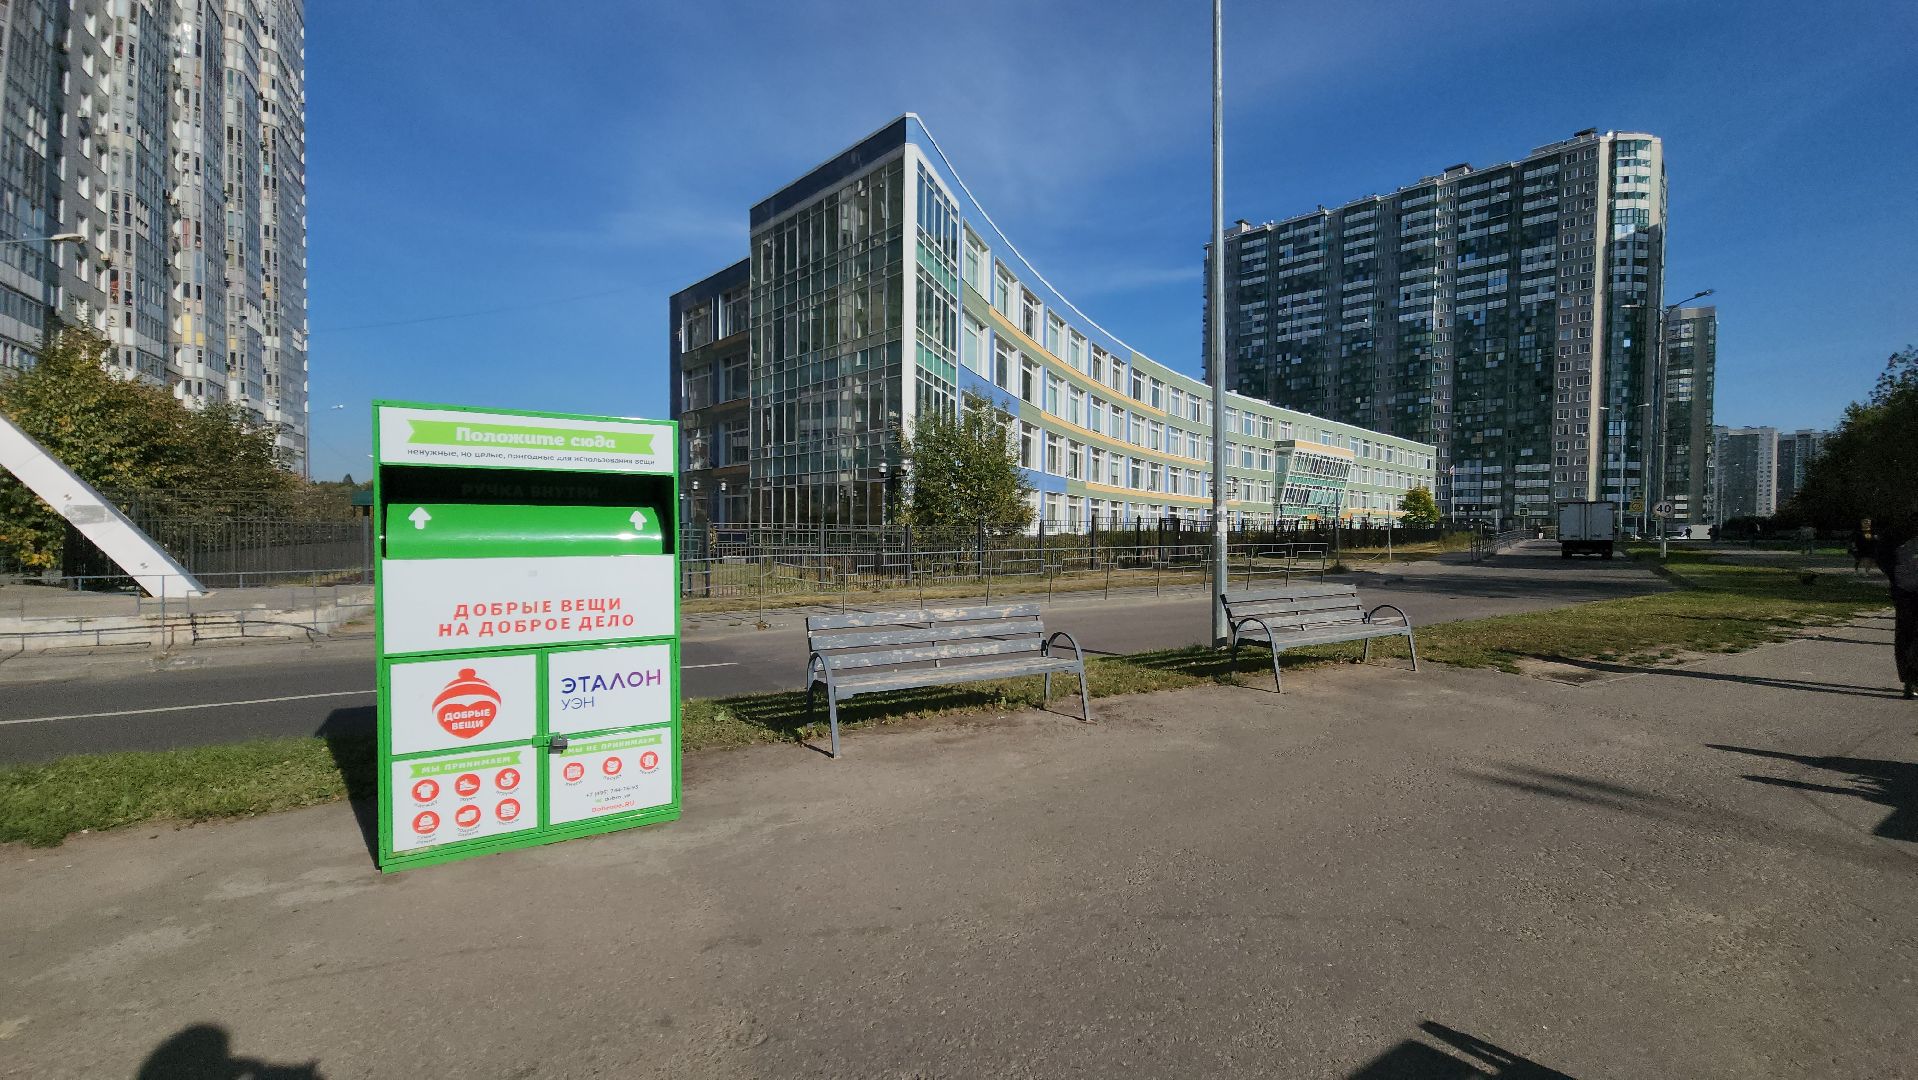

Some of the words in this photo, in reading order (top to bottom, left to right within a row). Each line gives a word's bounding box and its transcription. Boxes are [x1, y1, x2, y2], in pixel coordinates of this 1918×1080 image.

[455, 426, 565, 446] Положите
[571, 434, 617, 449] сюда
[1656, 504, 1672, 513] 40
[453, 600, 552, 621] ДОБРЫЕ
[560, 597, 622, 614] ВЕЩИ
[438, 622, 470, 638] НА
[478, 617, 571, 638] ДОБРОЕ
[578, 613, 635, 632] ДЕЛО
[560, 668, 662, 695] ЭТАЛОН
[561, 695, 595, 711] УЭН
[443, 708, 491, 722] ДОБРЫЕ
[451, 719, 484, 731] ВЕЩИ
[421, 765, 440, 774] МЫ
[444, 756, 511, 771] ПРИНИМАЕМ
